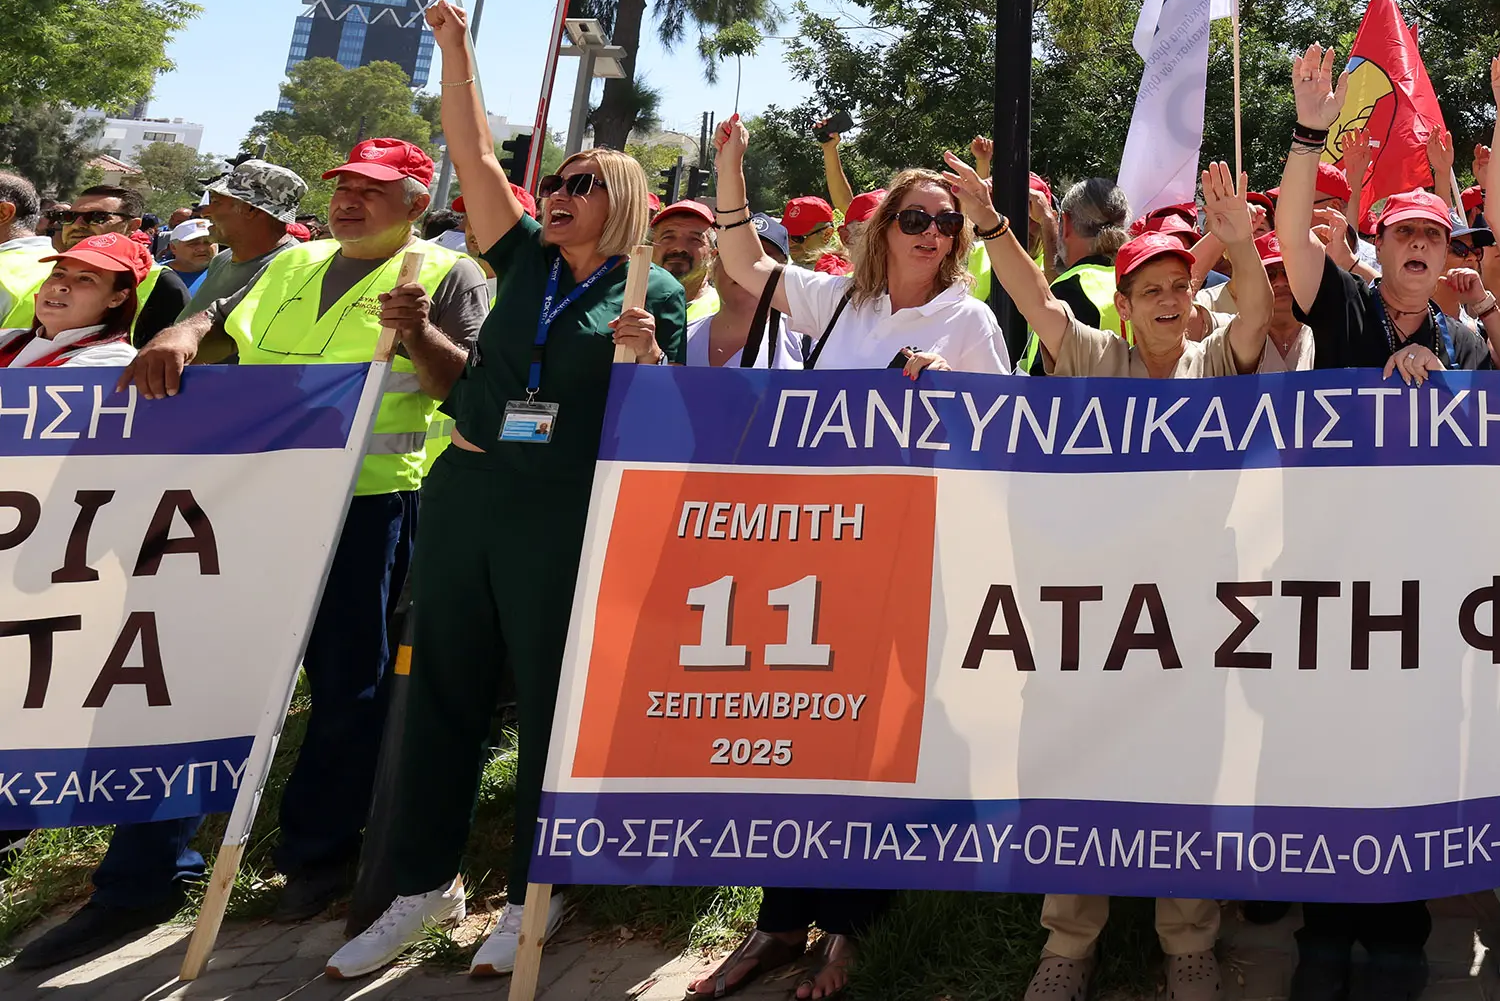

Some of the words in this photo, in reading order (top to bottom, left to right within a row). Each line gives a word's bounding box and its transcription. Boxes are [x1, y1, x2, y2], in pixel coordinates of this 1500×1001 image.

[354, 302, 381, 310] ΟΙΚΟΔΟ
[677, 501, 865, 541] ΠΕΜΠΤΗ
[679, 574, 834, 671] 11
[961, 582, 1184, 672] ΑΤΑ
[1213, 579, 1421, 671] ΣΤΗ
[646, 691, 866, 721] ΣΕΠΤΕΜΒΡΙΟΥ
[710, 737, 793, 767] 2025
